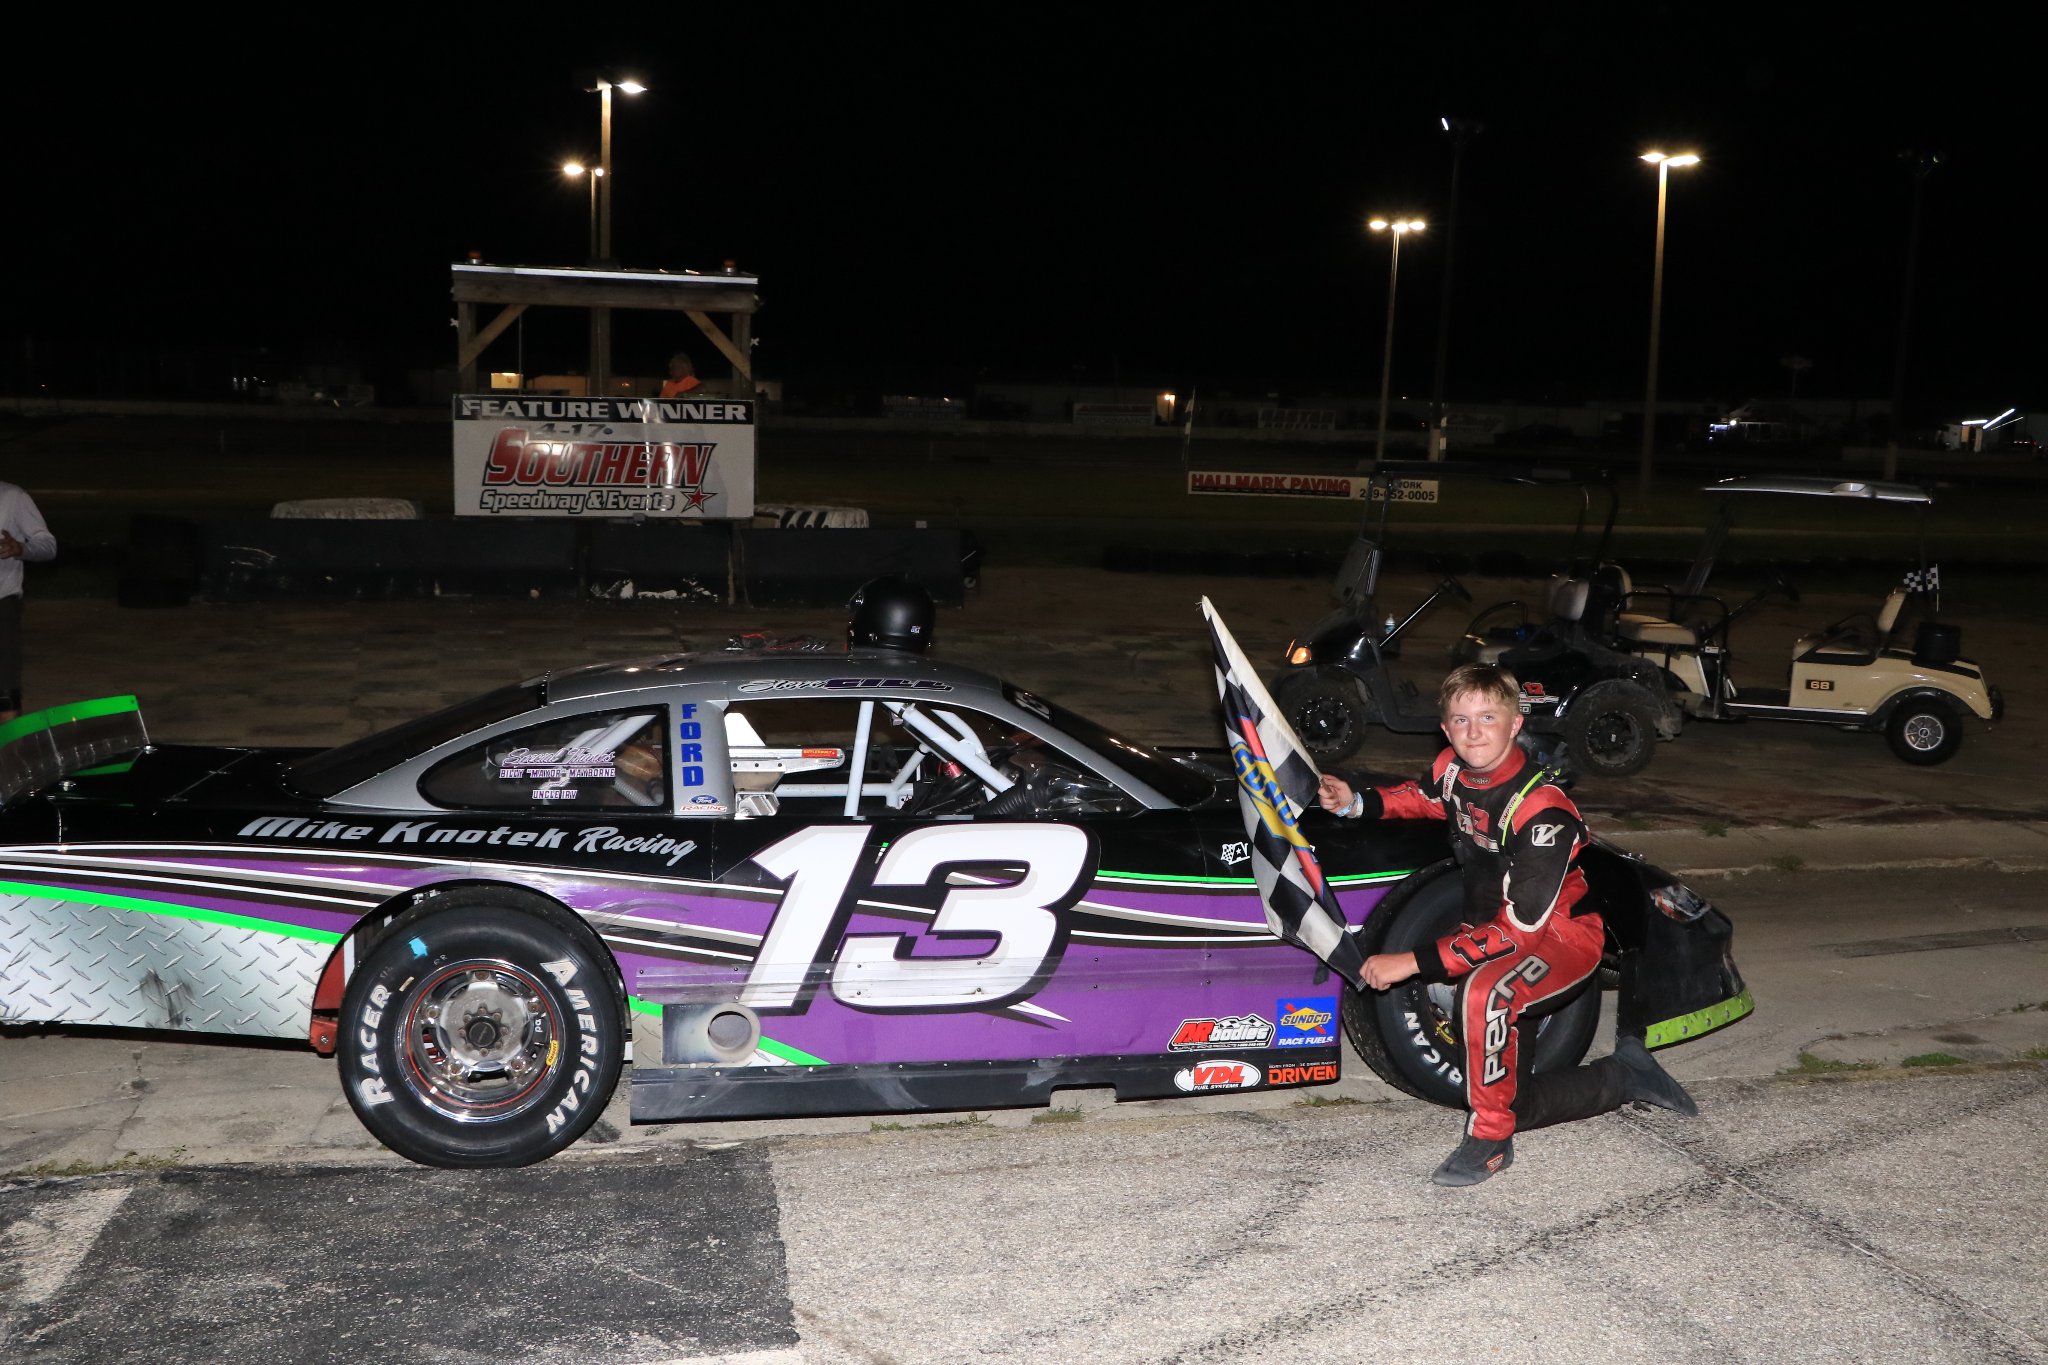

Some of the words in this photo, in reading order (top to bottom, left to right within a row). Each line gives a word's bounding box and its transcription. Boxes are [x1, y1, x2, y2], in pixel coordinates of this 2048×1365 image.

[461, 401, 610, 419] FEATURE
[616, 402, 748, 421] WINNER
[482, 427, 717, 488] SOUTHERN
[1192, 474, 1288, 490] HALLMARK
[1291, 476, 1351, 492] PAVING
[480, 489, 586, 512] Speedway
[586, 490, 604, 510] &
[602, 490, 674, 511] Events
[1360, 488, 1435, 500] 29-52-0005
[824, 678, 955, 693] GILL
[1810, 681, 1830, 690] 68
[680, 704, 705, 787] FORD
[532, 789, 560, 800] UNCLE
[561, 789, 578, 800] IRV
[237, 816, 374, 841] Mike
[379, 821, 569, 850] Knotek
[573, 827, 698, 867] Racing
[737, 822, 1090, 1011] 13
[1280, 1012, 1331, 1026] SUNOCO
[1209, 1022, 1272, 1042] bodies
[1278, 1036, 1304, 1046] RACE
[1304, 1035, 1334, 1044] FUELS
[360, 984, 397, 1106] RACER
[540, 957, 602, 1135] AMERICAN
[1194, 1066, 1246, 1085] VDL
[1268, 1065, 1338, 1085] DRIVEN
